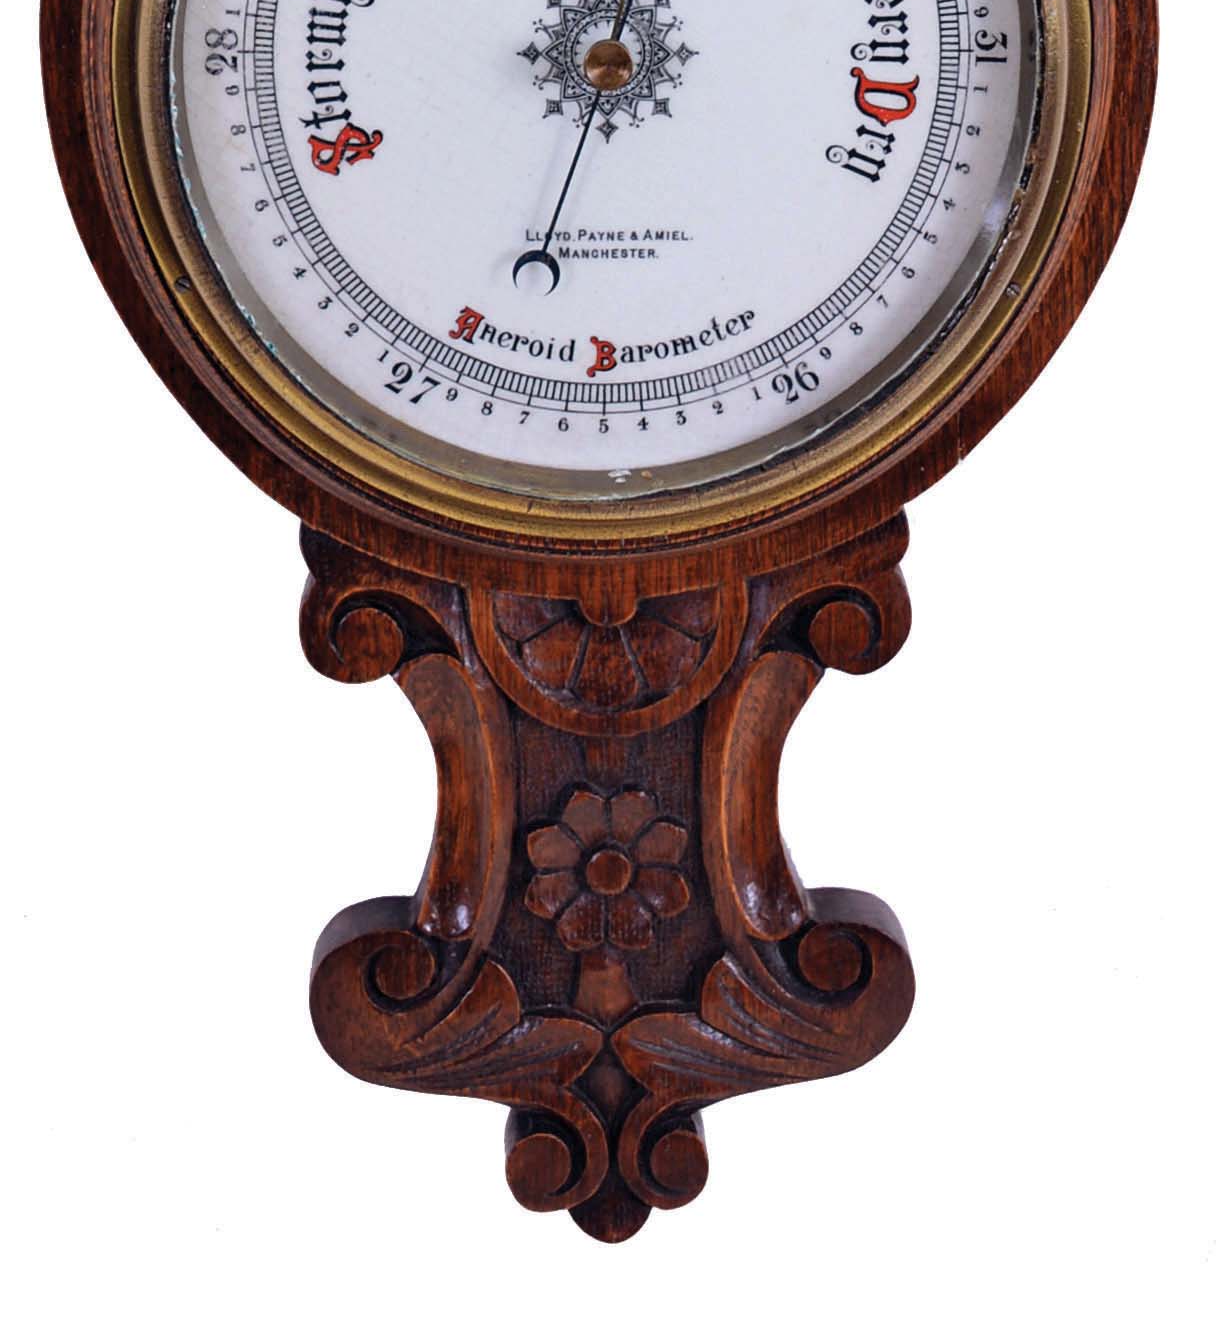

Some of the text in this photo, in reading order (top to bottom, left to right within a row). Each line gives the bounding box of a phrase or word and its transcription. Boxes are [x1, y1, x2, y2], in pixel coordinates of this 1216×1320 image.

[225, 9, 241, 17] 1
[973, 5, 990, 19] 9
[204, 28, 239, 76] 28
[974, 29, 1008, 64] 31
[224, 84, 240, 97] 9
[973, 85, 989, 94] 1
[229, 124, 247, 137] 8
[825, 66, 920, 183] Dry
[965, 124, 981, 137] 2
[239, 162, 257, 172] 7
[954, 161, 971, 175] 3
[254, 199, 270, 213] 6
[942, 197, 957, 211] 4
[272, 234, 289, 248] 5
[577, 228, 625, 242] PAYNE
[629, 231, 639, 241] &
[922, 231, 938, 245] 5
[293, 267, 308, 280] 4
[901, 266, 916, 280] 6
[317, 296, 334, 310] 3
[876, 294, 889, 308] 7
[344, 322, 360, 338] 2
[848, 321, 864, 336] 8
[448, 306, 756, 377] Aneroid Barometer
[377, 349, 390, 363] 1
[819, 346, 832, 360] 9
[384, 361, 441, 404] 27
[771, 362, 820, 404] 26
[445, 387, 459, 402] 9
[751, 386, 762, 401] 1
[480, 400, 494, 416] 8
[711, 400, 724, 415] 2
[519, 410, 531, 425] 7
[557, 417, 570, 432] 6
[637, 416, 649, 431] 4
[675, 410, 687, 426] 3
[598, 418, 610, 434] 5
